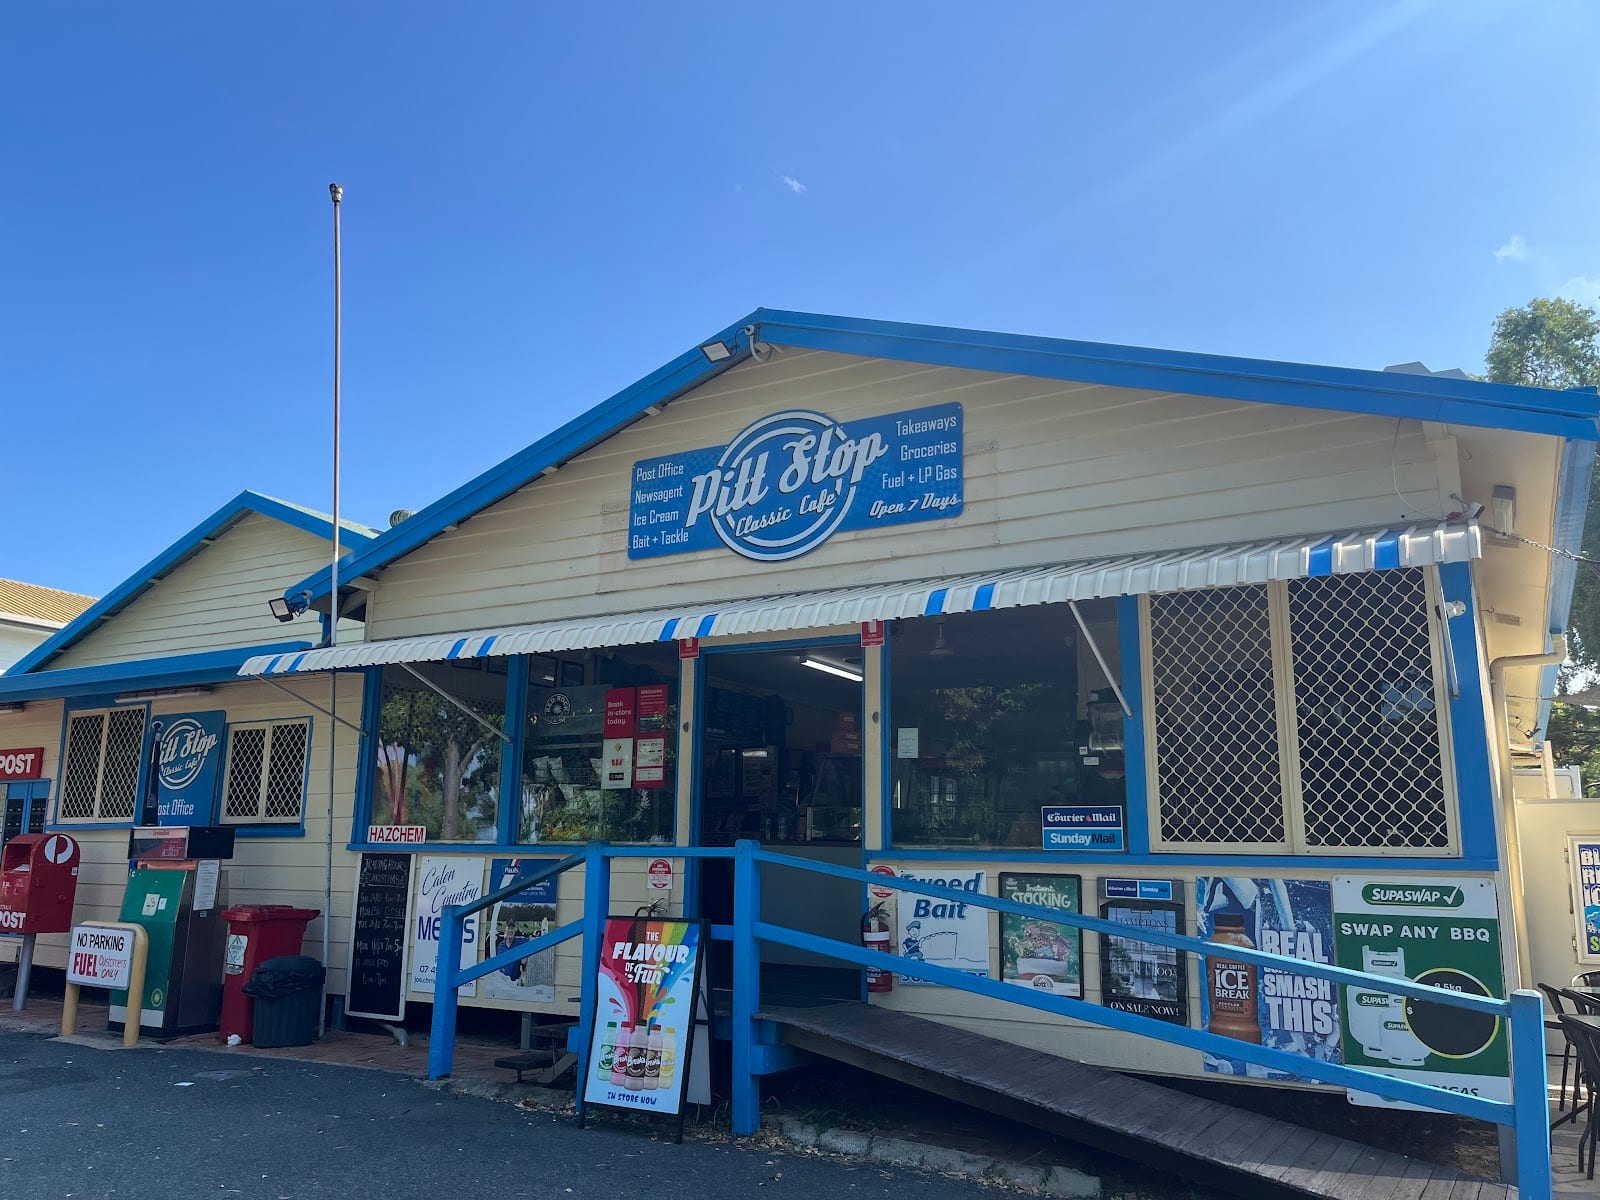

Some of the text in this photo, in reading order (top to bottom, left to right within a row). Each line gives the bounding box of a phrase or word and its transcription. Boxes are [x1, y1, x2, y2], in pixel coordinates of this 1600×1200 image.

[896, 416, 957, 436] Takeaways
[901, 440, 957, 460] Groceries
[636, 463, 684, 481] Post Office
[685, 430, 889, 527] Pitt Stop
[882, 471, 904, 489] Fuel
[919, 466, 932, 483] LP
[936, 465, 957, 480] Gas
[635, 486, 683, 504] Newsagent
[869, 493, 961, 518] Open 7 Days
[634, 509, 679, 527] Ice Cream
[735, 507, 792, 537] Classic
[632, 534, 650, 549] Bait
[661, 528, 689, 545] Tackle
[607, 709, 632, 717] in-store
[607, 718, 626, 726] today
[158, 799, 194, 816] ost Office
[1047, 813, 1085, 823] Courier
[1092, 813, 1116, 822] Mail
[369, 827, 424, 843] HAZCHEM
[431, 880, 479, 914] Country
[1372, 888, 1440, 903] SUPASWAP
[914, 899, 967, 919] Bait
[417, 916, 475, 943] MES
[647, 932, 659, 941] THE
[1341, 923, 1490, 943] SWAP ANY BBQ
[77, 933, 125, 951] NO PARKING
[1261, 930, 1329, 963] REAL
[612, 942, 690, 964] FLAVOUR
[73, 952, 97, 977] FUEL
[625, 963, 662, 985] OF Fun
[1215, 969, 1249, 990] ICE
[1264, 973, 1331, 1000] SMASH
[1215, 988, 1250, 1000] BREAK
[1110, 1001, 1180, 1017] ON SALE NOW!
[1264, 996, 1333, 1035] THIS
[608, 1091, 657, 1105] IN STORE NOW
